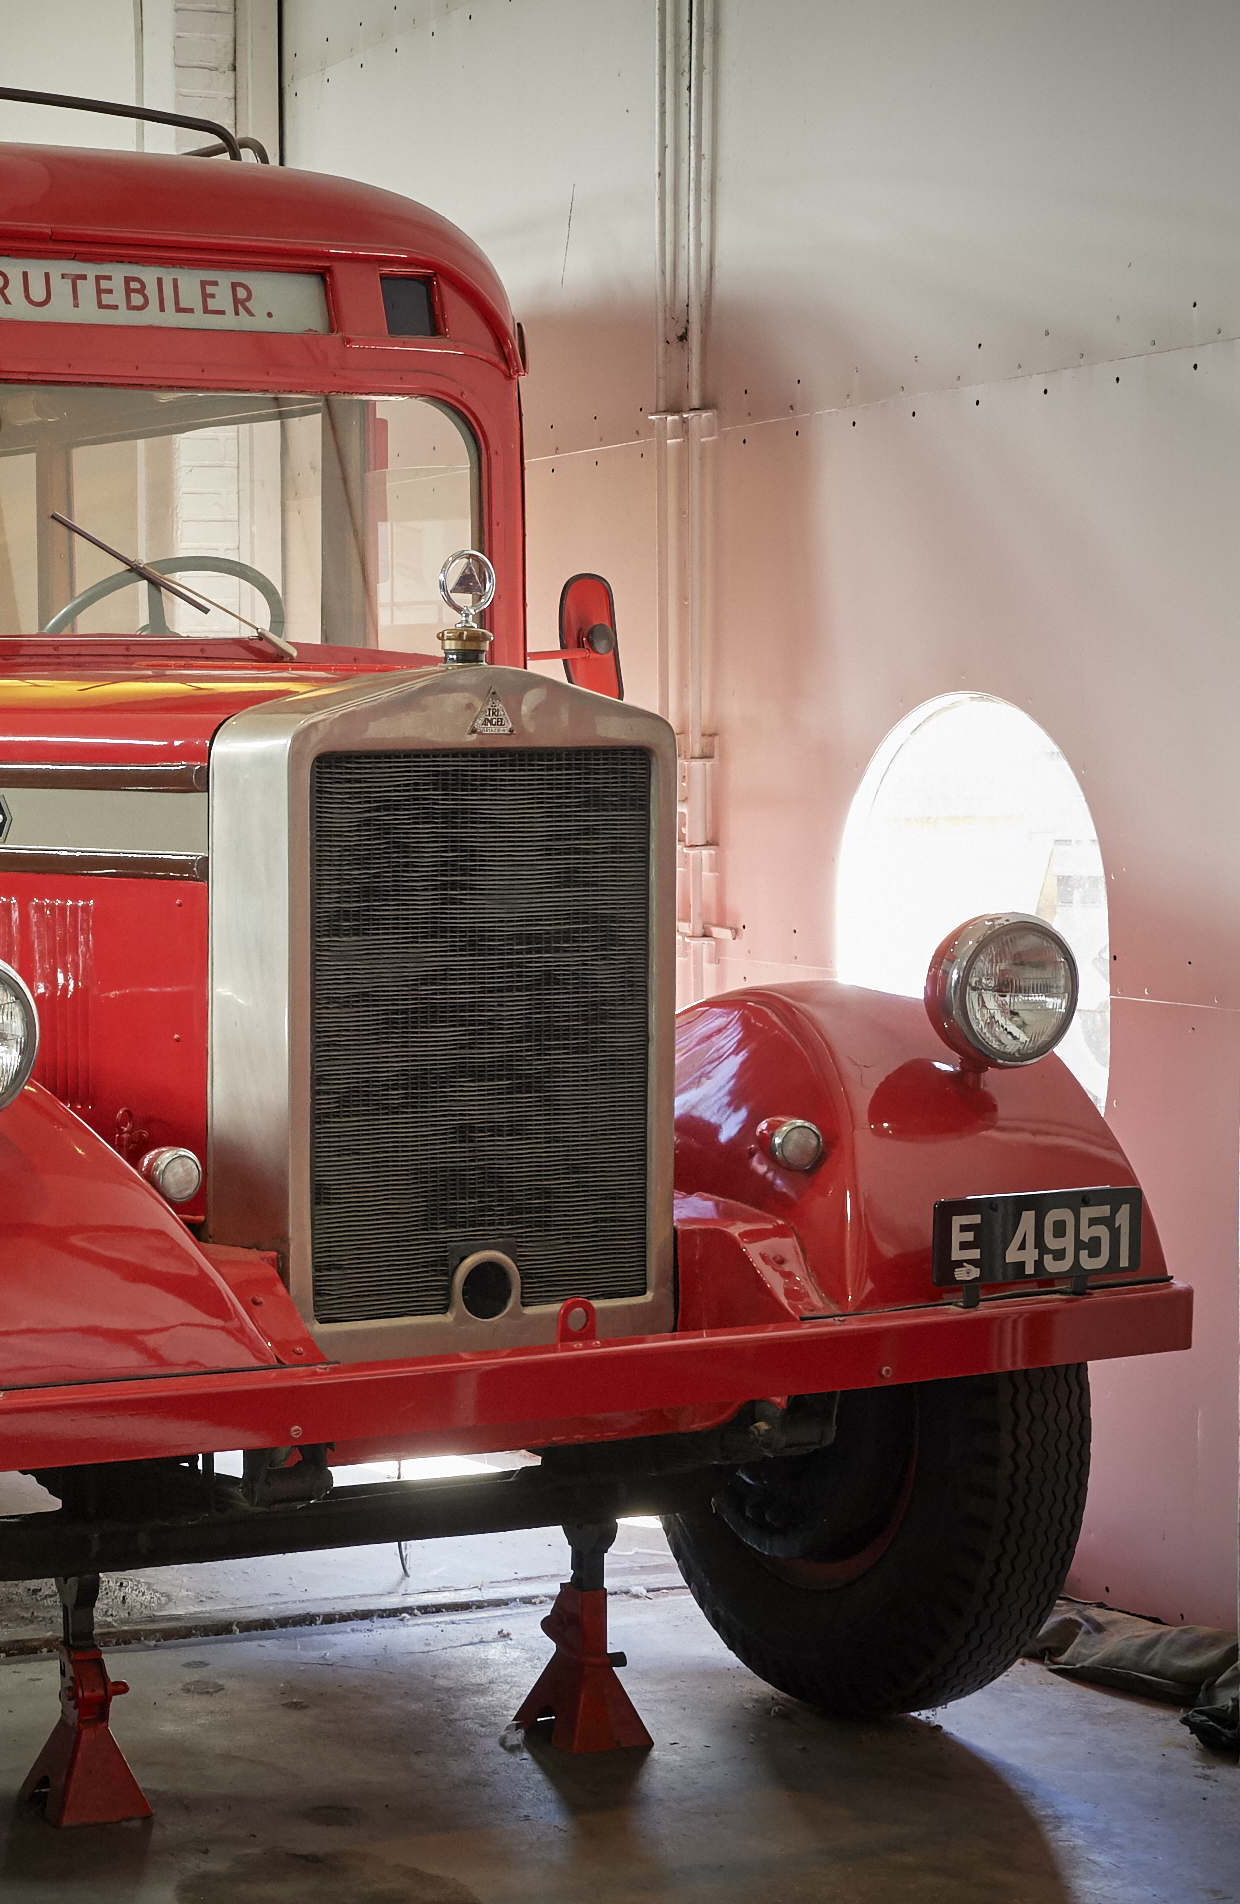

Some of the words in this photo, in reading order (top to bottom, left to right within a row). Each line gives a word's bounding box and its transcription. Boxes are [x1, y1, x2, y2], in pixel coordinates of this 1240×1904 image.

[481, 717, 506, 727] ANGEL
[950, 1213, 982, 1261] E
[1005, 1203, 1131, 1275] 4951
